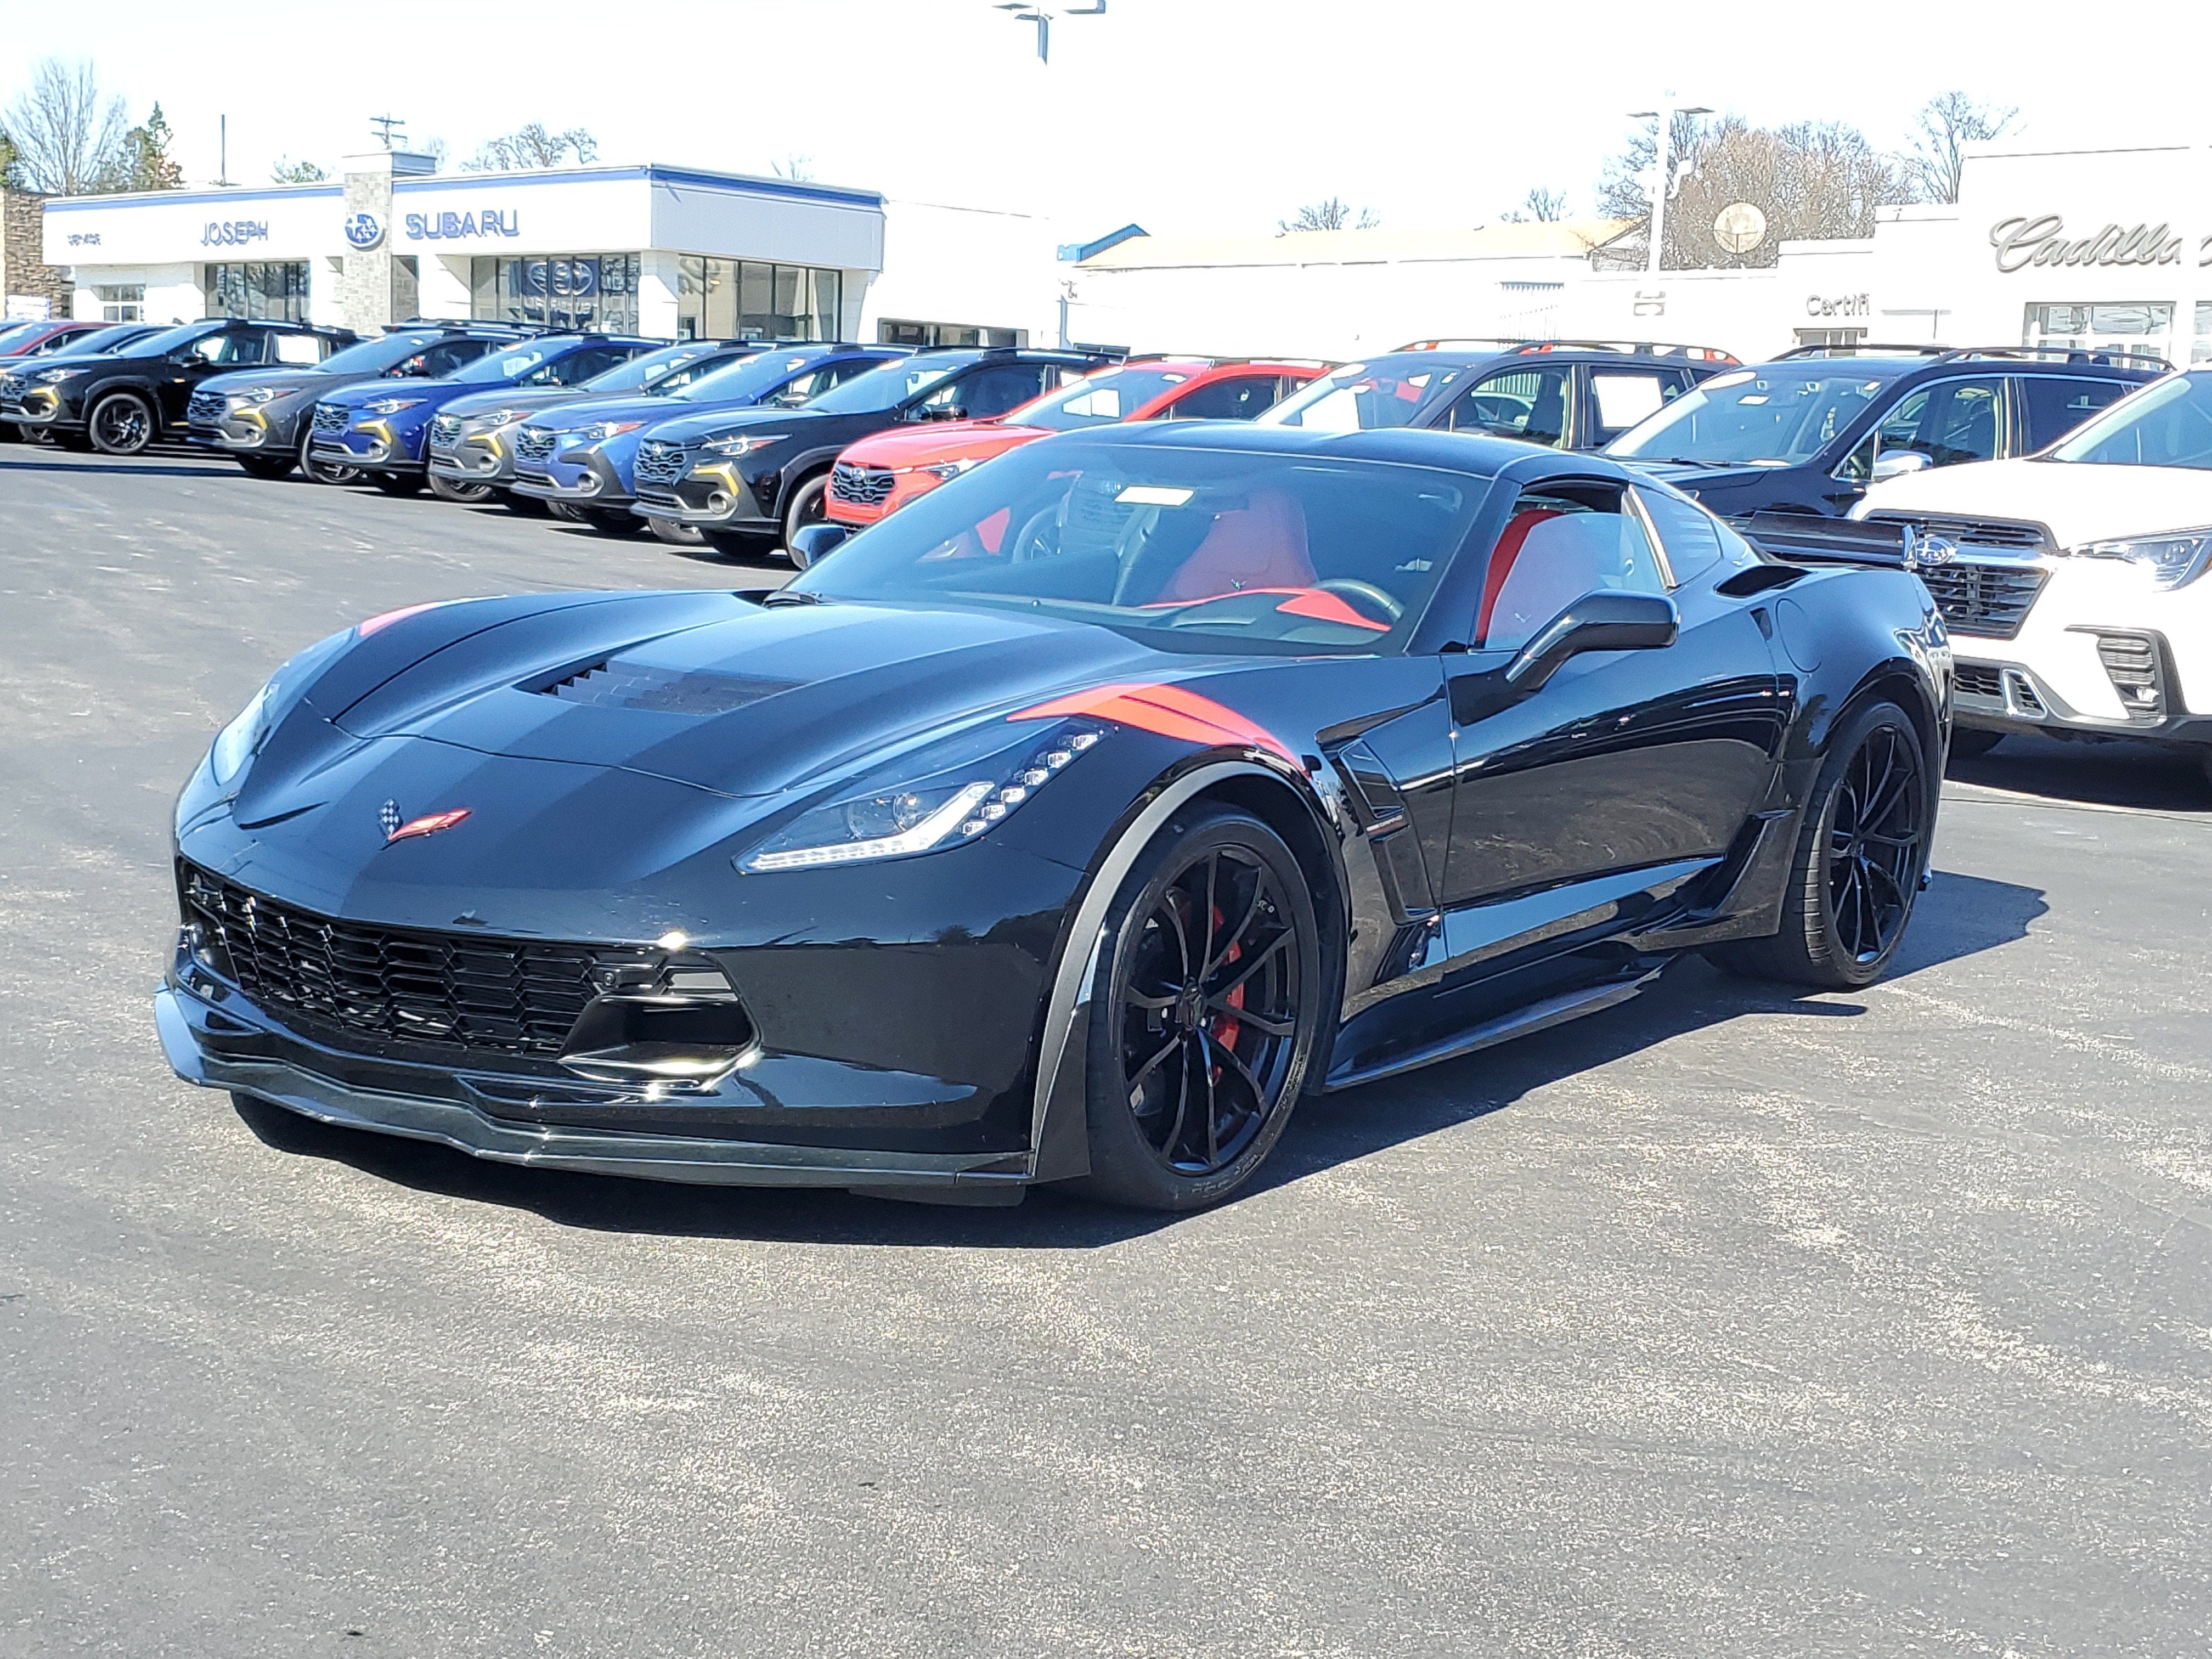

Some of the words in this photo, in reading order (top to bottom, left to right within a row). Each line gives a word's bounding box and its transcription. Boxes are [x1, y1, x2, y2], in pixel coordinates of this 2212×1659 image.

[200, 220, 268, 246] JOSEPH
[406, 210, 520, 240] SUBARU
[1807, 293, 1869, 317] Certifi
